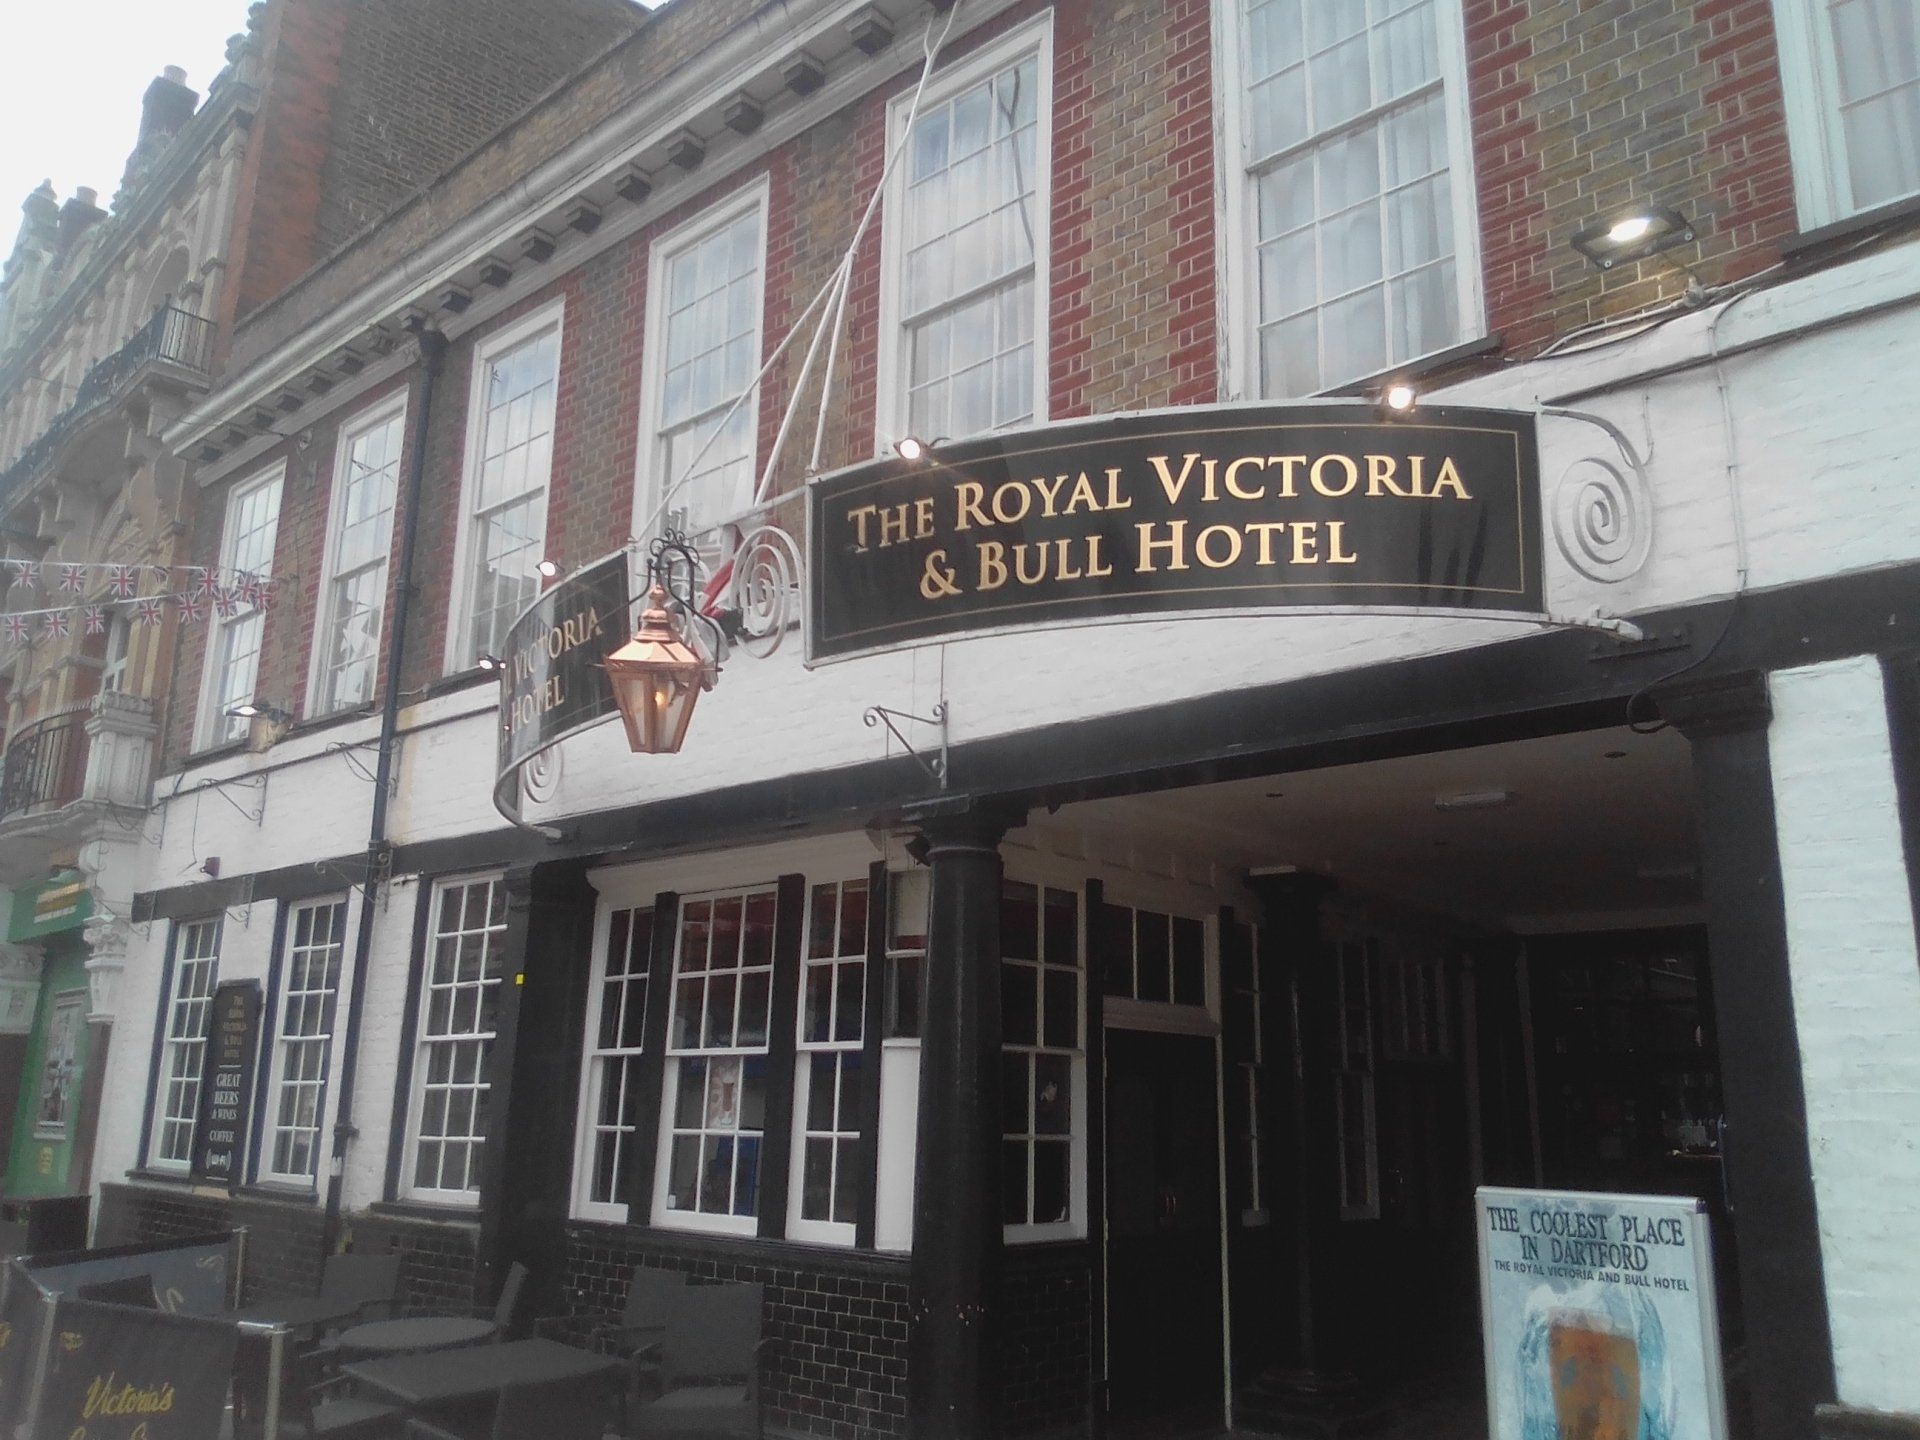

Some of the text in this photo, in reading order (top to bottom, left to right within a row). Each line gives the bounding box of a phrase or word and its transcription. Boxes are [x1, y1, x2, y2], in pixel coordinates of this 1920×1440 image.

[848, 453, 1472, 554] THE ROYAL VICTORIA
[920, 520, 1358, 600] & BULL HOTEL
[514, 607, 602, 685] VICTORIA
[512, 675, 564, 735] HOTEL
[214, 1091, 239, 1105] BEERS
[216, 1073, 242, 1087] GREAT
[1486, 1206, 1686, 1246] THE COOLEST PLACE
[1519, 1234, 1648, 1271] IN DARTFORD
[1494, 1259, 1690, 1292] THE ROYAL VICTORIA AND BULL HOTEL
